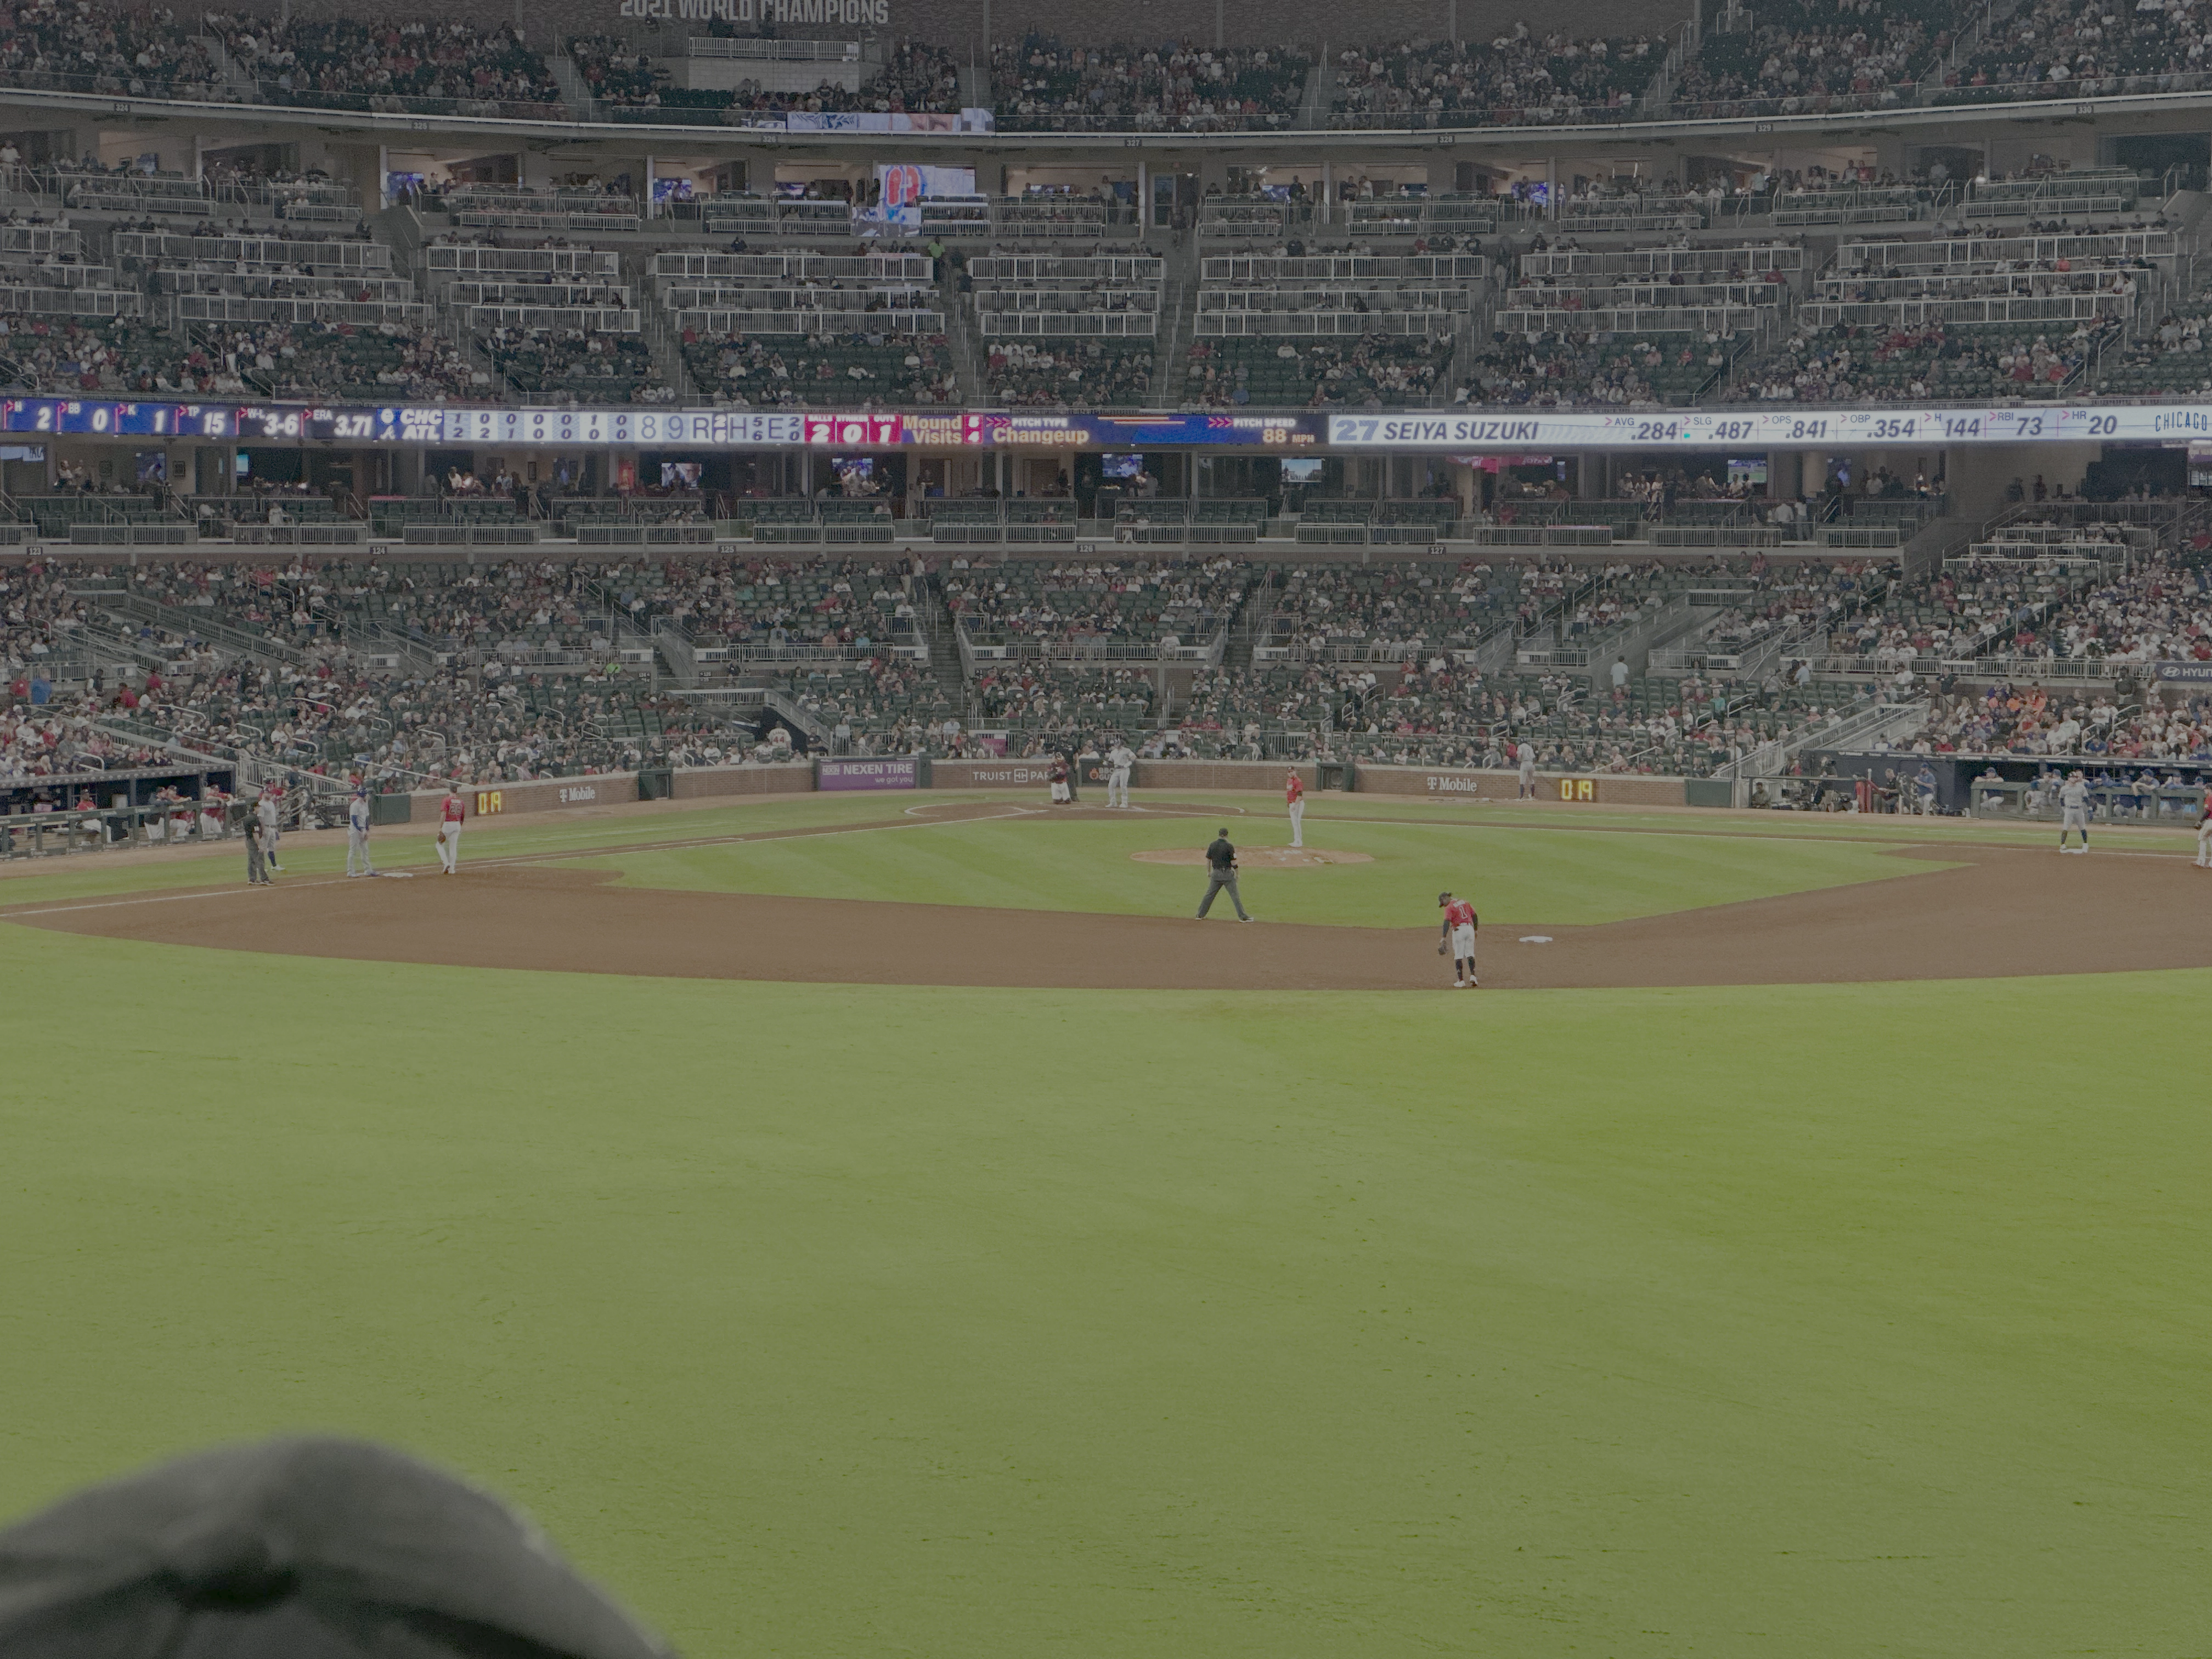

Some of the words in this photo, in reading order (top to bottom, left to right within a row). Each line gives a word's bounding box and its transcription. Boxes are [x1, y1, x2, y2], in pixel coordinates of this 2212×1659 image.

[620, 0, 672, 18] 2021
[679, 0, 752, 21] WORLD
[760, 0, 889, 24] CHAMPIONS
[116, 104, 128, 112] 324
[2078, 106, 2092, 114] 330
[1758, 124, 1771, 132] 329
[37, 407, 51, 430] 2
[92, 409, 108, 431] 0
[154, 410, 165, 432] 1
[313, 410, 332, 420] ERA
[400, 409, 443, 425] CHC
[455, 414, 461, 424] 1
[480, 413, 490, 424] 0
[506, 413, 516, 425] 0
[533, 414, 544, 425] 0
[561, 414, 572, 425] 0
[591, 414, 597, 425] 1
[616, 415, 626, 426] 0
[752, 417, 763, 427] 5
[789, 417, 800, 427] 2
[902, 415, 962, 430] Mound
[968, 416, 979, 428] 5
[1012, 417, 1042, 427] PITCH
[1043, 417, 1068, 427] TYPE
[1615, 417, 1634, 426] AVG
[1772, 416, 1791, 424] OPS
[1850, 415, 1870, 423] OBP
[1997, 413, 2014, 421] RBI
[2072, 411, 2086, 419] HR
[2155, 411, 2207, 432] CHICAGO
[204, 412, 225, 434] 15
[263, 413, 298, 435] 3-6
[334, 415, 373, 436] 3.71
[641, 415, 656, 439] 8
[668, 415, 684, 439] 9
[693, 417, 709, 439] R
[730, 417, 747, 439] H
[769, 417, 784, 439] E
[1233, 418, 1262, 427] PITCH
[1264, 418, 1296, 428] SPEED
[1336, 420, 1379, 441] 27
[1383, 421, 1448, 440] SEIYA
[1454, 421, 1539, 440] SUZUKI
[1631, 422, 1677, 439] .284
[1708, 421, 1754, 439] .487
[1786, 420, 1827, 439] .841
[1867, 419, 1915, 438] .354
[1945, 417, 1980, 437] 144
[2016, 417, 2042, 436] 73
[2088, 415, 2118, 435] 20
[402, 425, 440, 439] ATL
[453, 428, 463, 438] 2
[479, 427, 490, 439] 2
[508, 427, 514, 439] 1
[533, 428, 544, 439] 0
[561, 428, 572, 439] 0
[589, 428, 599, 440] 0
[616, 429, 626, 440] 0
[752, 431, 763, 441] 6
[790, 431, 800, 441] 0
[811, 424, 830, 442] 2
[843, 424, 862, 442] 0
[879, 425, 891, 442] 1
[912, 430, 962, 444] Visits
[968, 430, 979, 442] 4
[992, 427, 1089, 444] Changeup
[1262, 428, 1287, 443] 88
[1292, 434, 1314, 443] MPH
[29, 547, 42, 555] 123
[843, 764, 883, 775] NEXEN
[885, 764, 913, 774] TIRE
[973, 771, 1012, 780] TRUIST
[886, 776, 898, 785] got
[1438, 777, 1477, 792] Mobile
[569, 786, 595, 801] Mobile
[1459, 905, 1468, 919] 1
